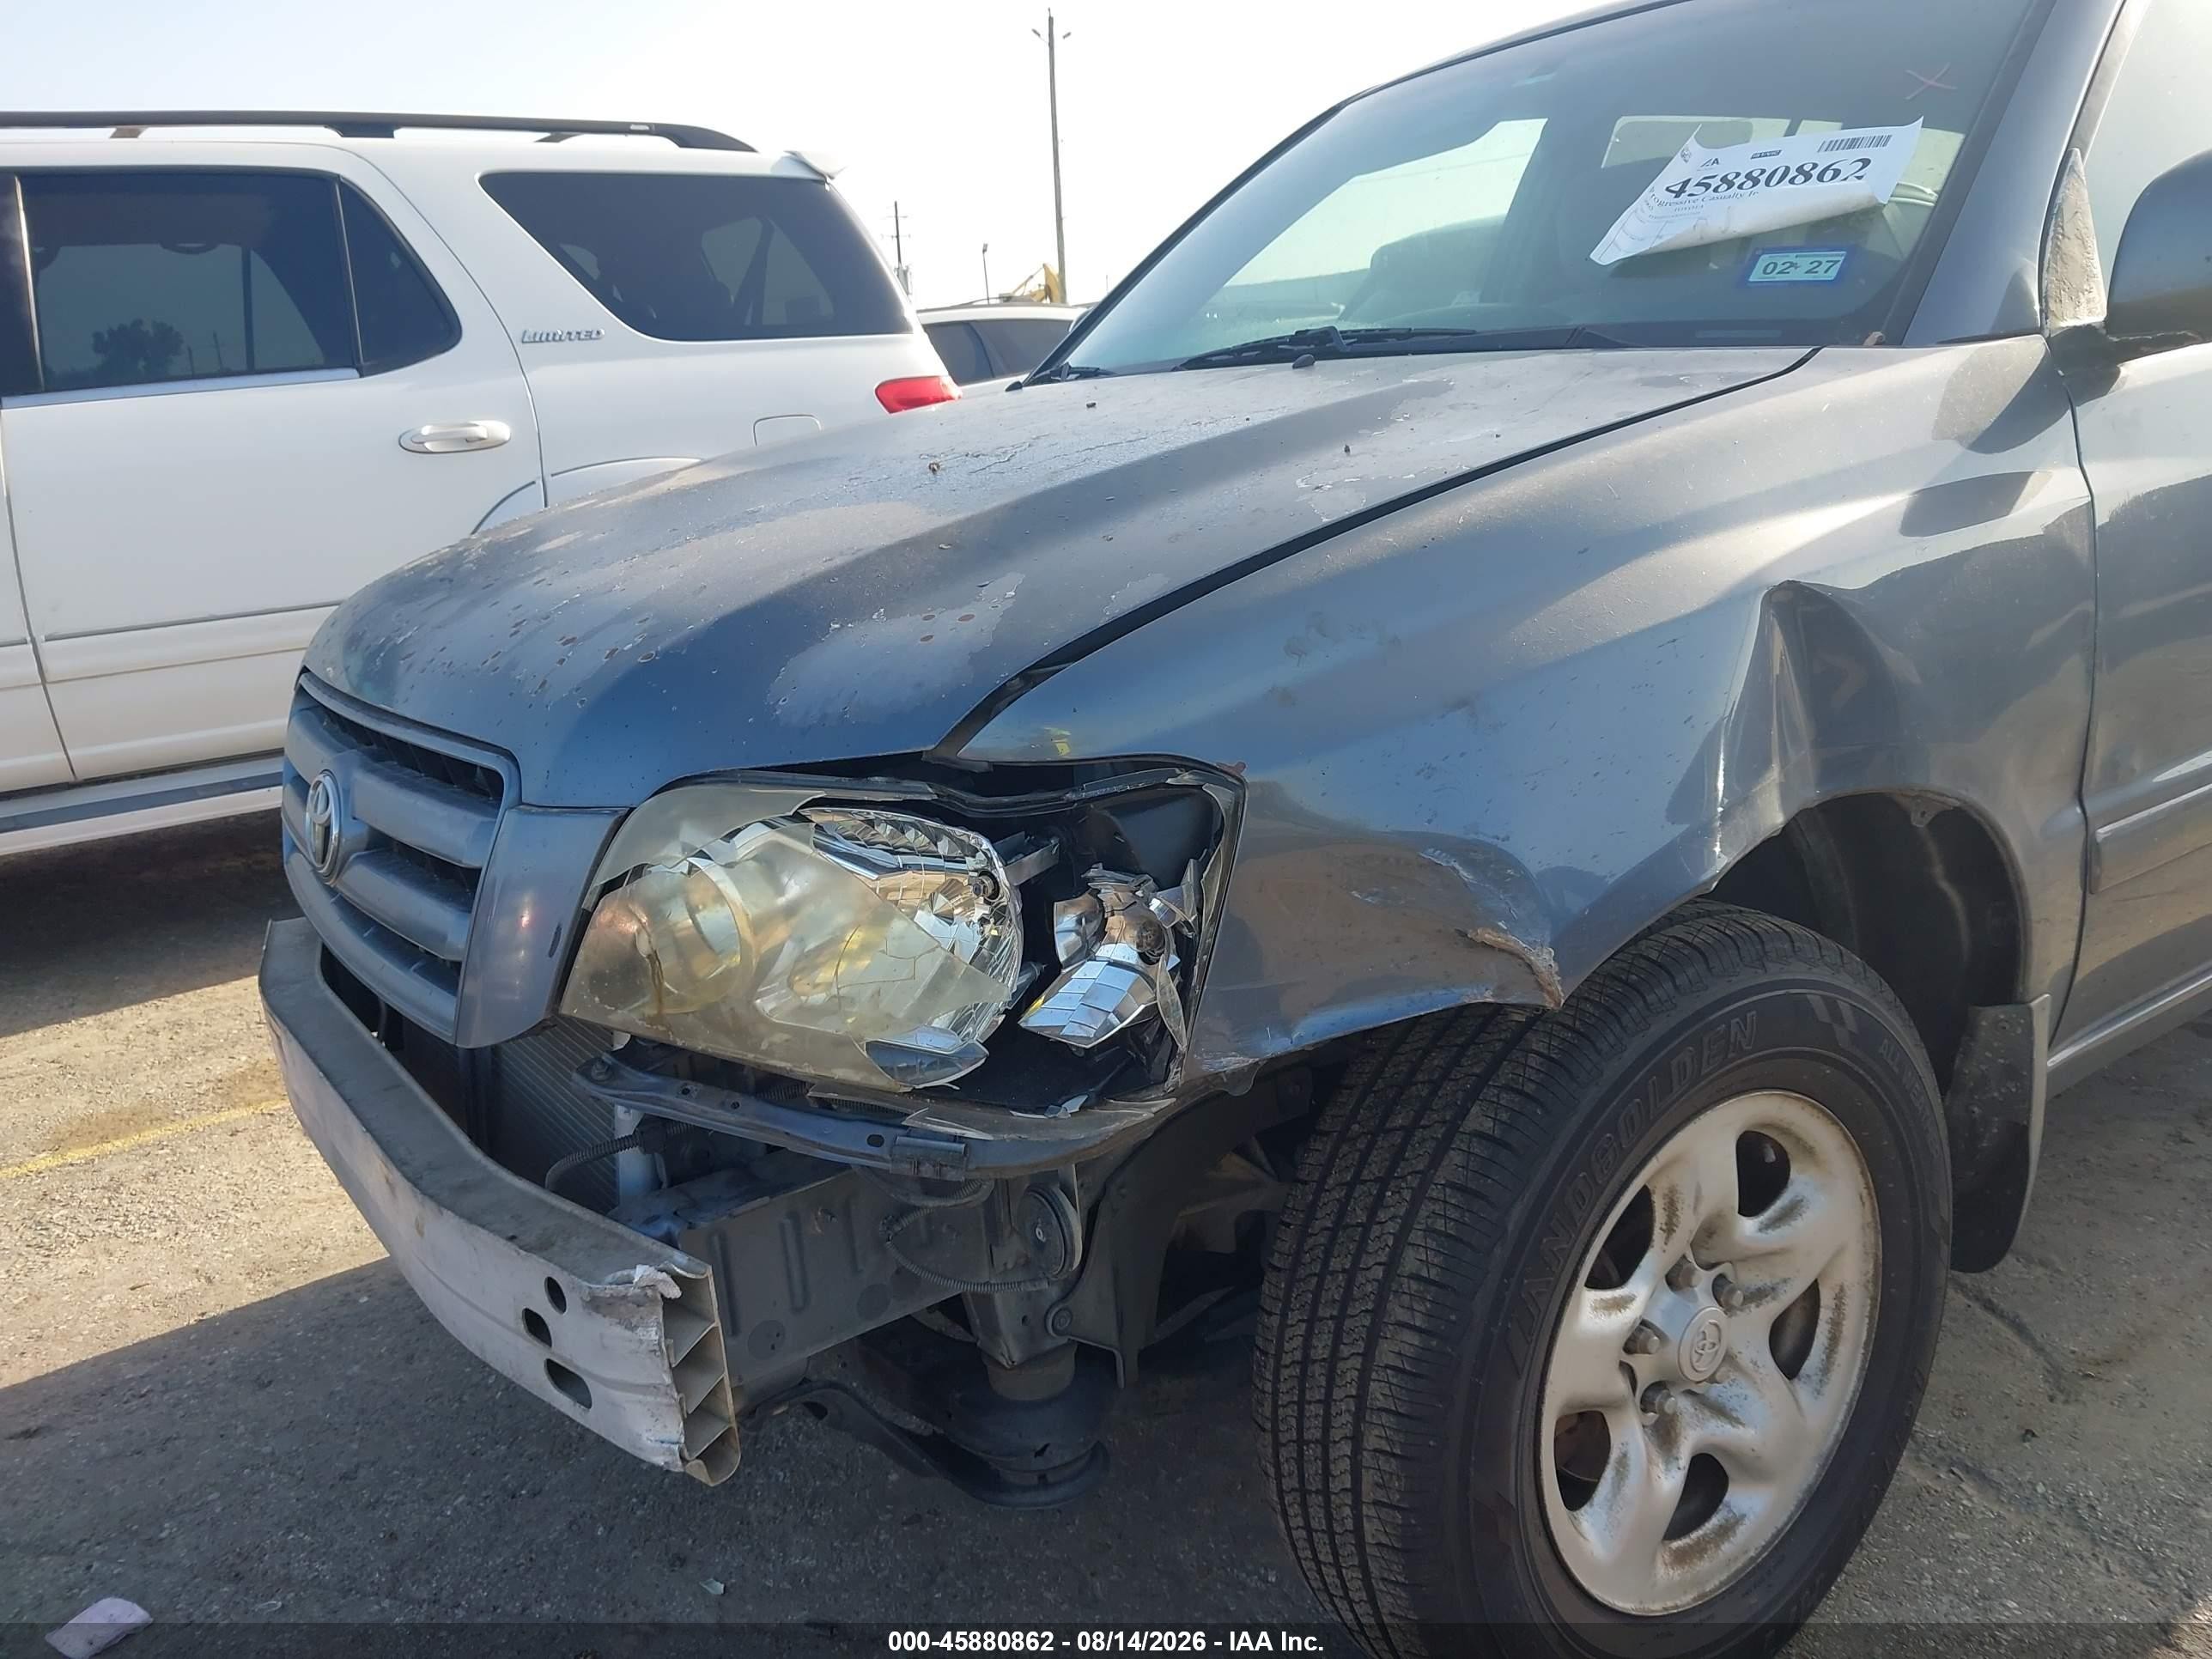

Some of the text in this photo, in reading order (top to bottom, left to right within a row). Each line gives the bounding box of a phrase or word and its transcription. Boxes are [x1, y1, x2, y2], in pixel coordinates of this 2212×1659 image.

[1665, 157, 1873, 199] 45880862
[1763, 259, 1842, 275] 02 27
